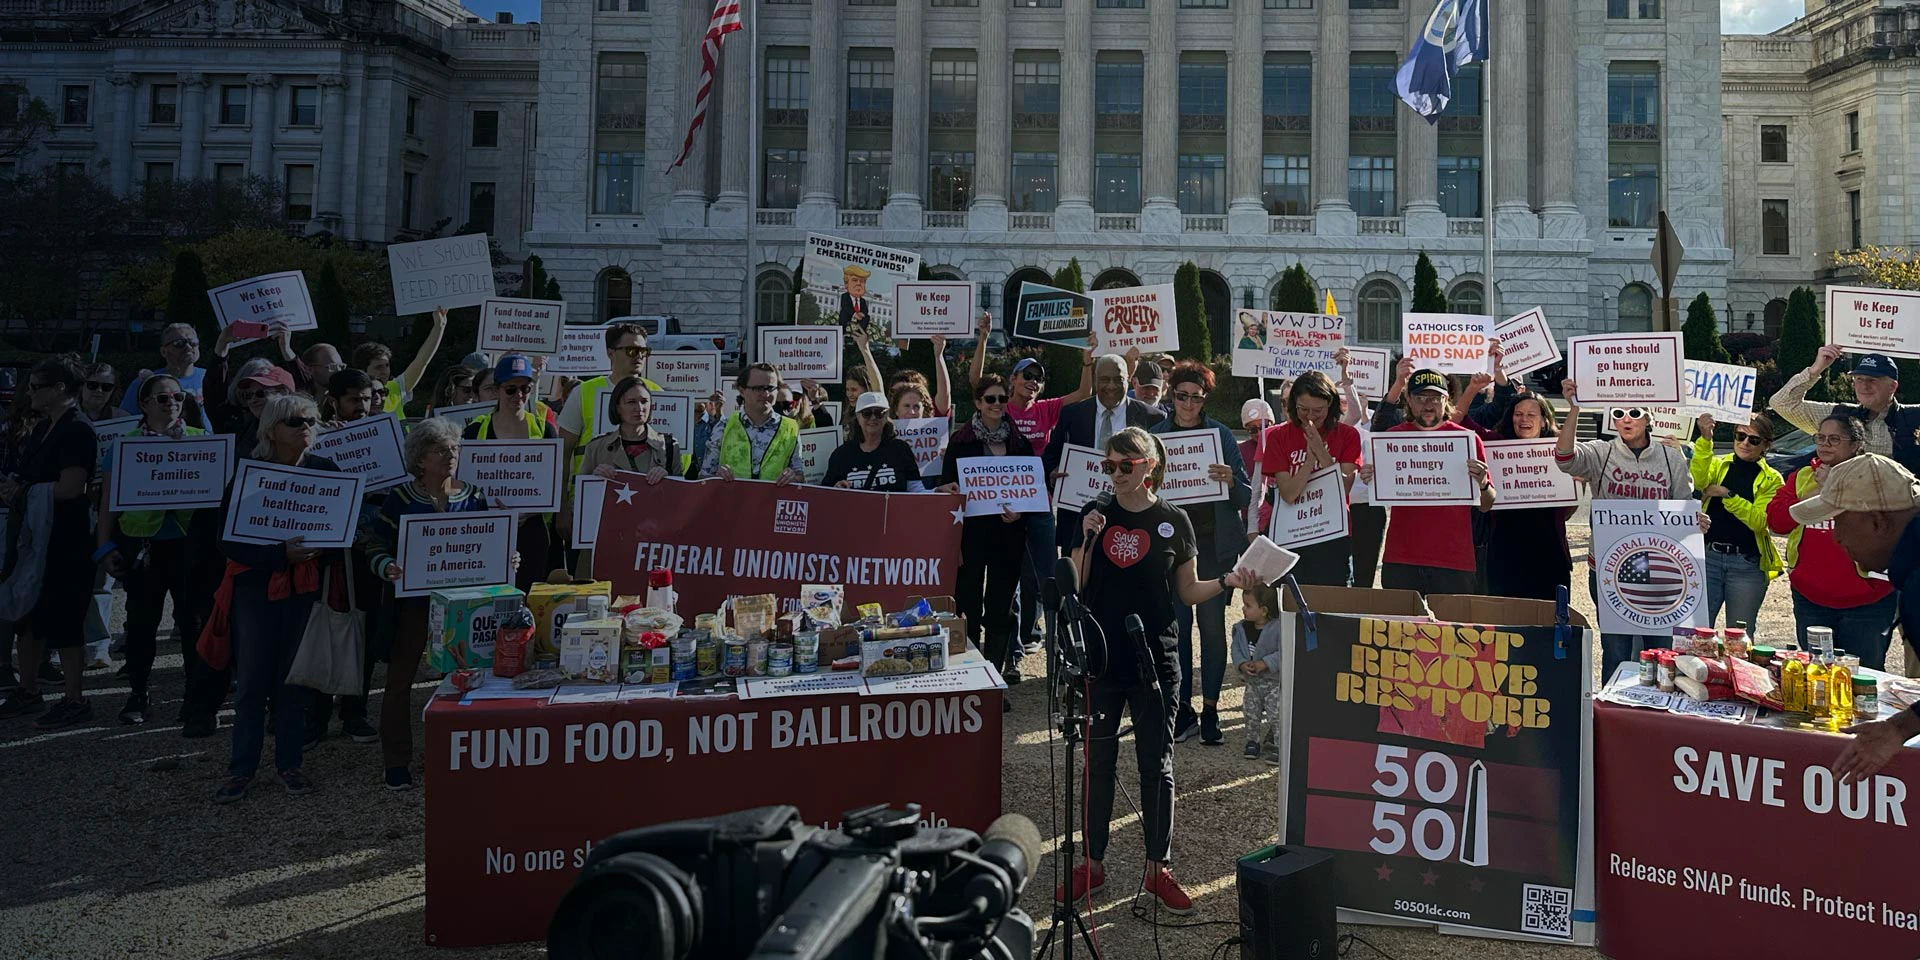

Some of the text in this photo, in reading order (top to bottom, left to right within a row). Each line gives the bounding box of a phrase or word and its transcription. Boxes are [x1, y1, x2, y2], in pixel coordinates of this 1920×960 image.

[396, 240, 488, 270] WE SHOULD
[810, 237, 914, 265] STOP SITTING ON SNAP
[816, 248, 905, 272] EMERGENCY FUNDS!
[400, 274, 493, 300] FEED PEOPLE
[240, 286, 282, 302] We Keep
[915, 292, 950, 303] We Keep
[1104, 294, 1157, 306] REPUBLICAN
[252, 299, 284, 314] Us Fed
[494, 308, 550, 318] Fund food and
[920, 306, 948, 316] Us Fed
[1027, 302, 1071, 318] FAMILIES
[1854, 300, 1898, 315] We Keep
[498, 320, 542, 332] healthcare,
[1042, 318, 1085, 330] BILLIONAIRES
[1104, 305, 1160, 334] CRUELTY
[1860, 317, 1894, 330] Us Fed
[1408, 323, 1484, 332] CATHOLICS FOR
[491, 334, 547, 344] not ballrooms.
[774, 336, 828, 345] Fund food and
[1120, 338, 1134, 346] THE
[1136, 336, 1158, 345] POINT
[1274, 329, 1304, 339] STEAL
[1308, 332, 1327, 340] FROM
[1409, 333, 1484, 345] MEDICAID
[780, 350, 824, 358] healthcare,
[1268, 346, 1280, 354] TO
[1281, 348, 1300, 356] GIVE
[1318, 351, 1335, 359] THE
[1409, 347, 1484, 360] AND SNAP
[1589, 344, 1660, 355] No one should
[656, 361, 710, 371] Stop Starving
[789, 363, 829, 371] ballrooms.
[1255, 365, 1284, 376] I THINK
[1598, 360, 1649, 373] go hungry
[666, 374, 699, 382] Families
[1596, 377, 1655, 386] in America.
[1684, 368, 1755, 409] SHAME
[1386, 442, 1454, 453] No one should
[136, 450, 217, 465] Stop Starving
[471, 452, 543, 463] Fund food and
[1493, 451, 1505, 460] No
[1508, 450, 1524, 459] one
[963, 465, 1014, 474] CATHOLICS
[1396, 459, 1444, 471] go hungry
[1502, 464, 1548, 475] go hungry
[151, 469, 200, 480] Families
[477, 470, 535, 480] healthcare,
[879, 476, 896, 485] DC
[965, 475, 1035, 487] MEDICAID
[1395, 475, 1450, 485] in America.
[259, 476, 340, 497] Fund food and
[1502, 479, 1555, 490] in America.
[488, 486, 542, 497] ballrooms.
[968, 488, 1037, 501] AND SNAP
[1306, 488, 1323, 501] Keep
[262, 496, 328, 515] healthcare,
[777, 502, 806, 516] FUN
[1298, 504, 1322, 520] Us Fed
[250, 515, 334, 531] not ballrooms.
[1595, 510, 1699, 526] Thank You!
[422, 522, 495, 536] No one should
[1113, 531, 1140, 547] SAVE
[430, 543, 482, 556] go hungry
[1110, 546, 1139, 562] CFPB
[634, 542, 942, 586] FEDERAL UNIONISTS NETWORK
[1605, 537, 1697, 578] FEDERAL WORKERS
[427, 559, 486, 572] in America.
[1607, 590, 1695, 626] ARE TRUE PATRIOTS
[473, 616, 497, 631] QUE
[472, 630, 496, 643] PASA
[1351, 644, 1538, 695] REMOVE
[1335, 672, 1551, 729] RESTORE
[449, 695, 984, 772] FUND FOOD, NOT BALLROOMS
[1371, 744, 1458, 804] 50
[1673, 746, 1908, 827] SAVE OUR
[1368, 801, 1456, 861] 50
[485, 846, 514, 876] No
[524, 849, 565, 872] one
[1610, 852, 1920, 931] Release SNAP funds. Protect hea
[1393, 899, 1471, 920] 50501dc.com
